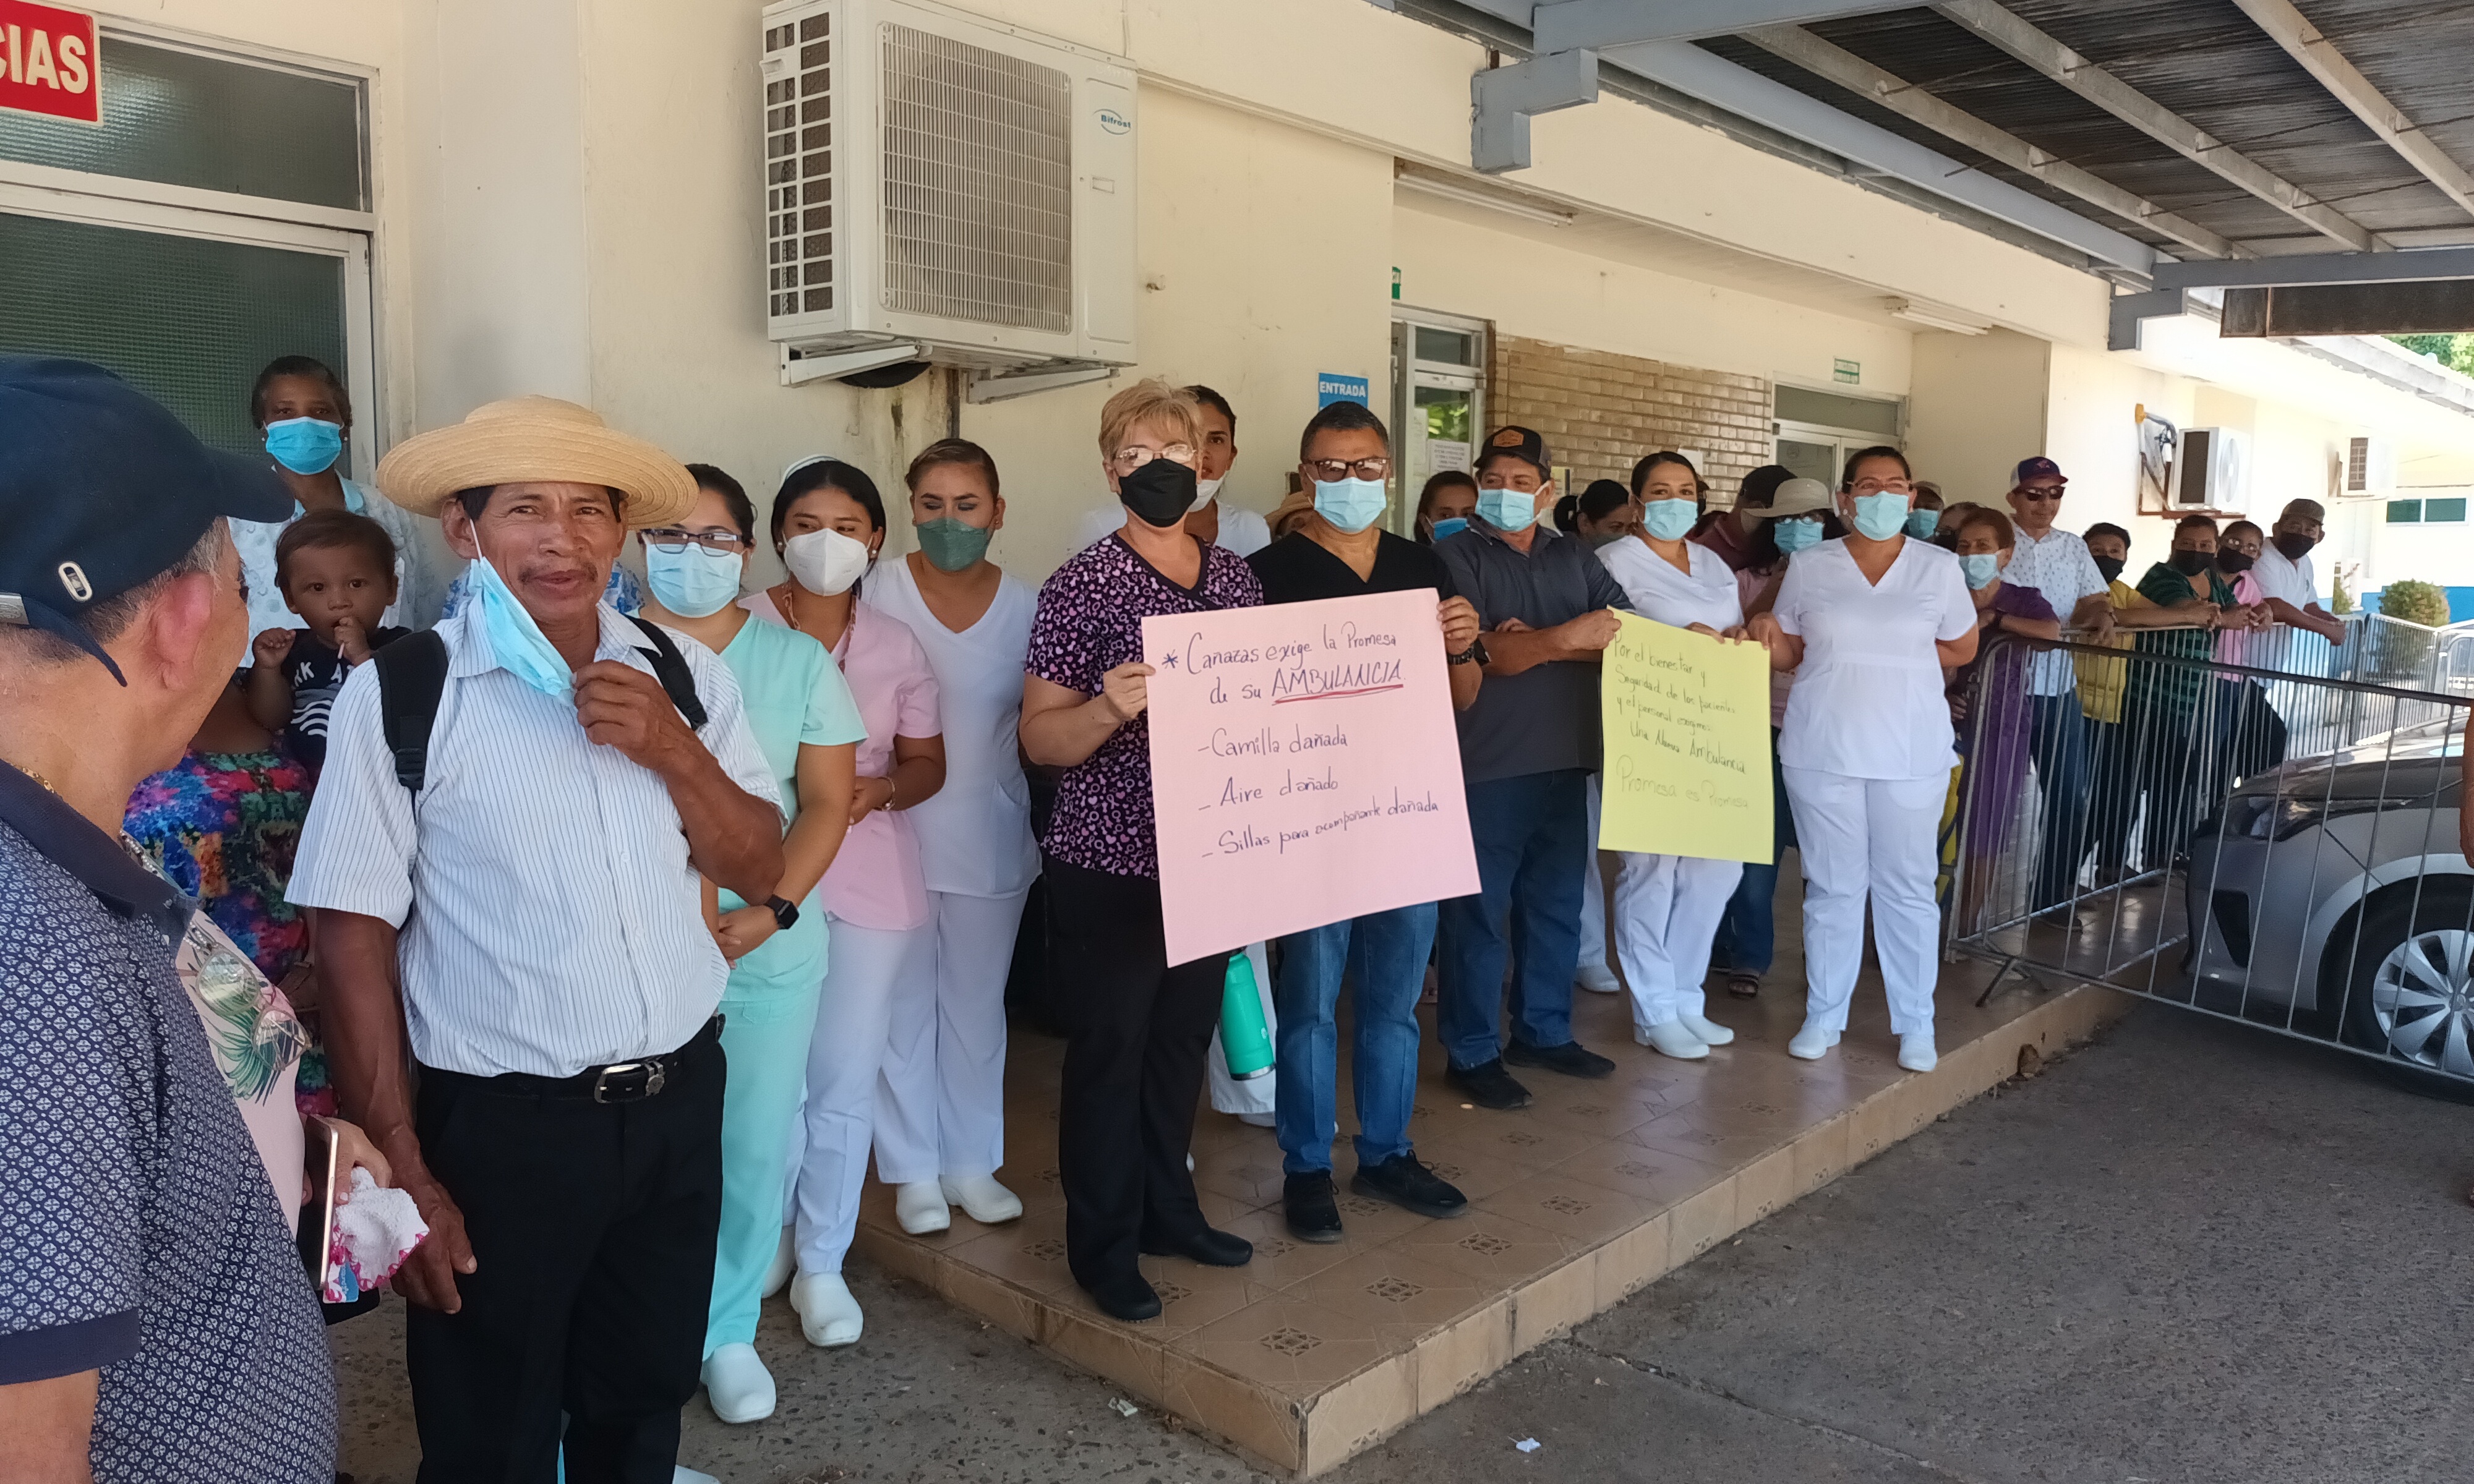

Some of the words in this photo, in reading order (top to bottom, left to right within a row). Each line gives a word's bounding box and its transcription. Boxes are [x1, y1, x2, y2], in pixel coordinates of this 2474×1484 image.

[1101, 114, 1131, 127] Bifrost
[1319, 381, 1366, 398] ENTRADA
[1265, 640, 1312, 671] exige
[1323, 624, 1337, 650] la
[1340, 621, 1396, 649] Promesa
[1614, 629, 1630, 659] Por
[1635, 642, 1643, 662] el
[1649, 644, 1693, 674] bienestar
[1210, 676, 1228, 704] de
[1666, 683, 1678, 701] de
[1684, 688, 1695, 704] los
[1617, 696, 1622, 715] y
[1626, 694, 1635, 707] el
[1638, 699, 1671, 722] personal
[1289, 723, 1348, 753] dañada
[1630, 720, 1648, 741] Una
[1616, 754, 1676, 797] Promesa
[1685, 790, 1700, 802] es
[1701, 779, 1748, 809] Promesa
[1279, 832, 1309, 855] para
[1387, 786, 1439, 816] dañada
